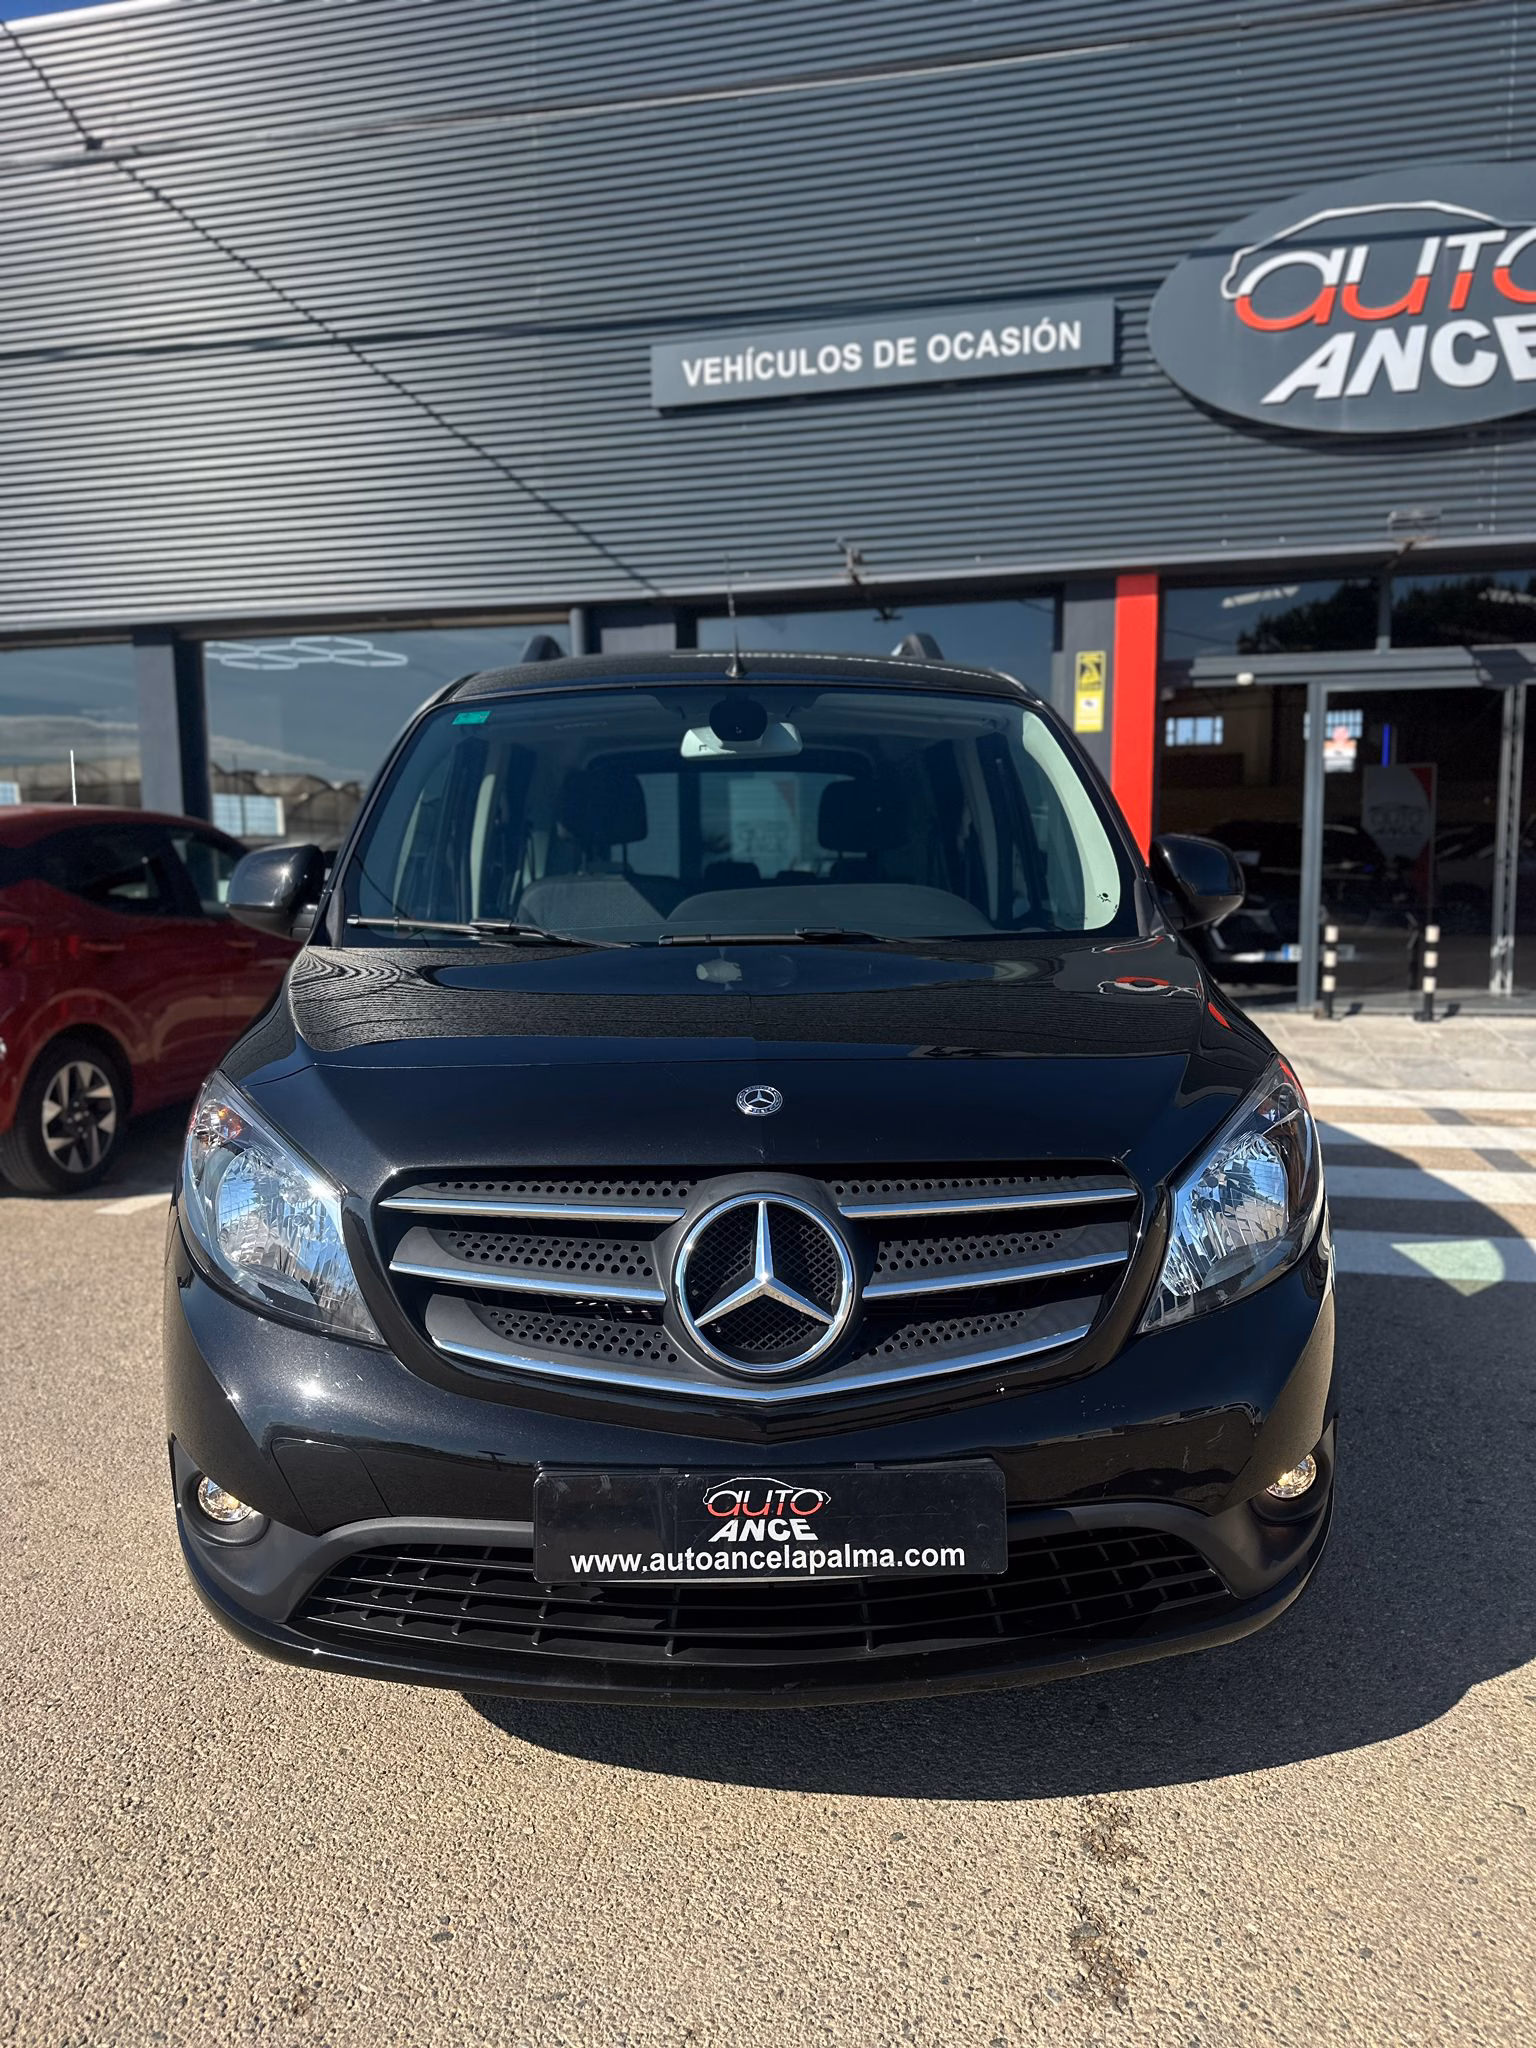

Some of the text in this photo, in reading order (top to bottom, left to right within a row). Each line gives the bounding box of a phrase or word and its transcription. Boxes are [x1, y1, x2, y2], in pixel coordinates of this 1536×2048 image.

[682, 317, 1082, 387] VEHÍCULOS DE OCASIÓN
[708, 1518, 819, 1543] ANCE
[570, 1543, 966, 1575] www.autoancelapalma.com
